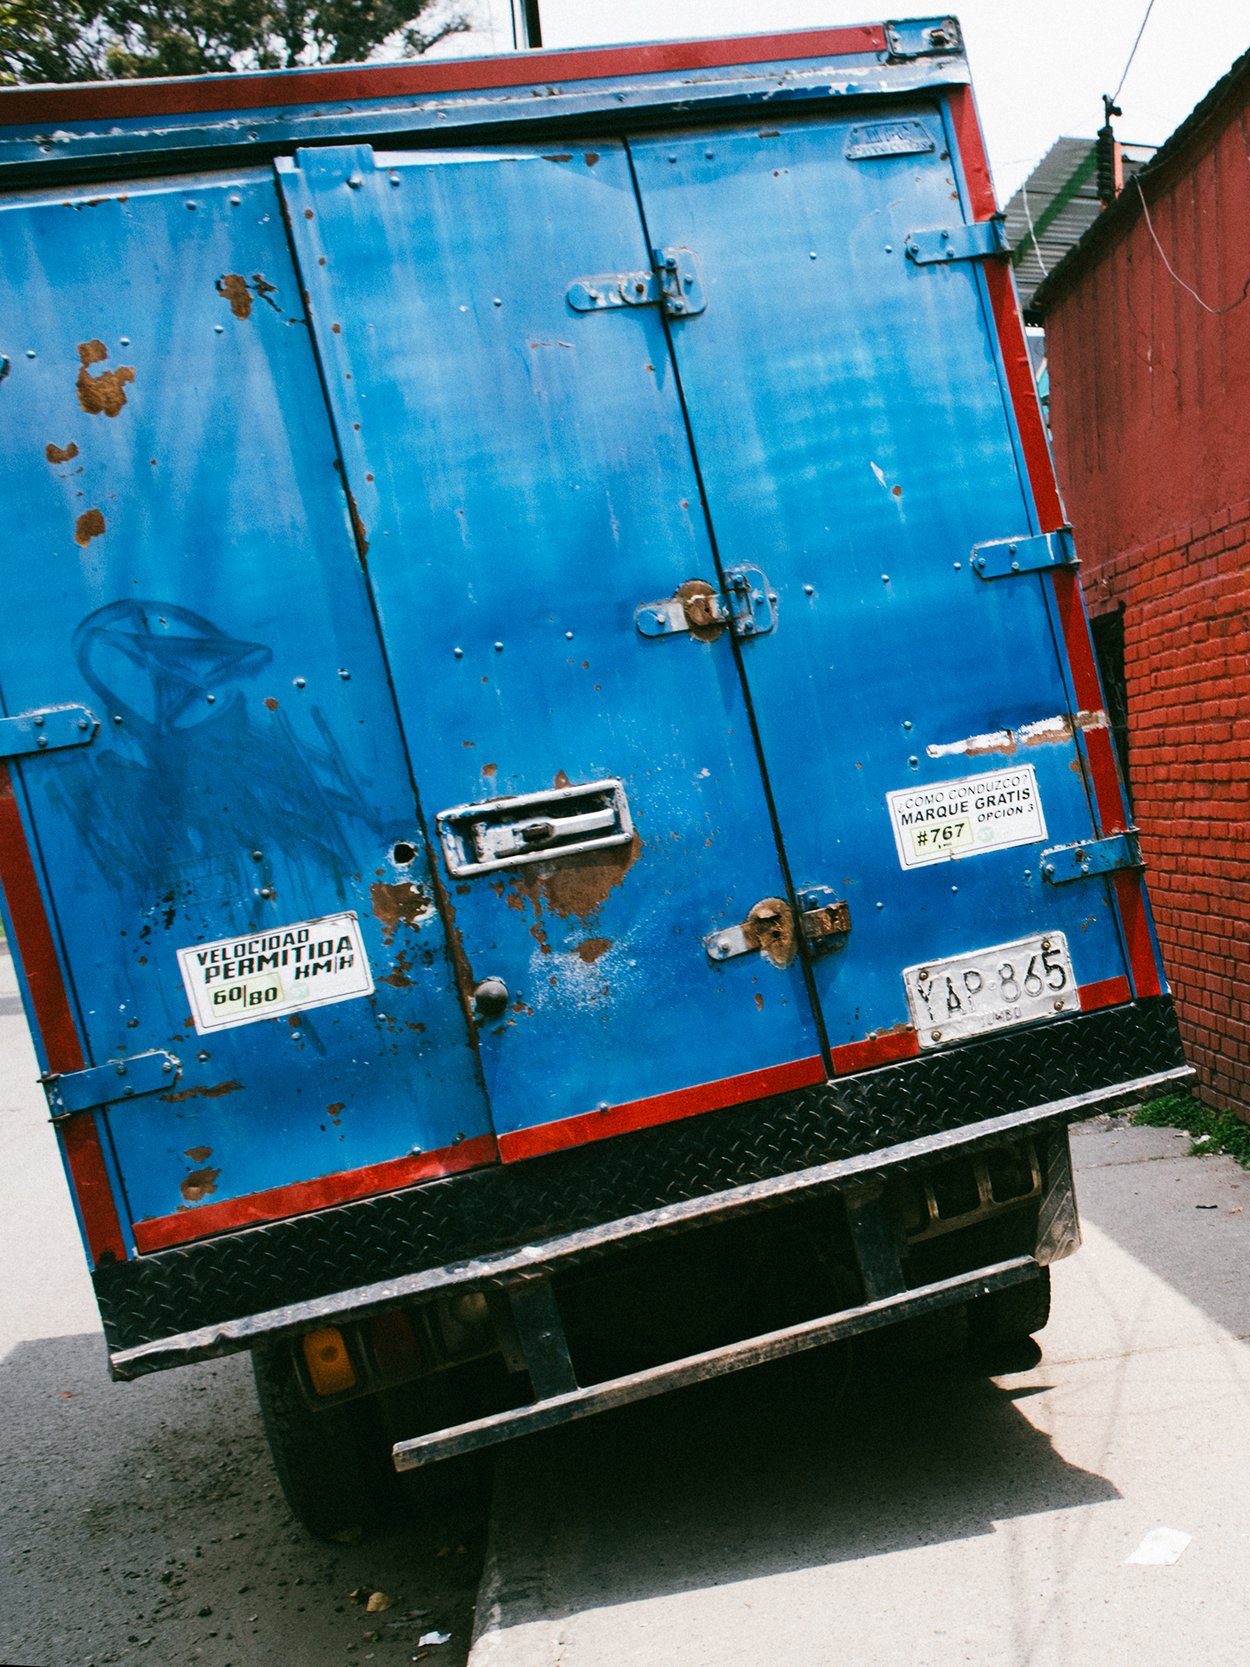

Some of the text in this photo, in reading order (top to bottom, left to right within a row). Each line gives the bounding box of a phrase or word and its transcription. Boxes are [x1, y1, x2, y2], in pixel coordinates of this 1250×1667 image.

[948, 774, 1028, 801] CONDUZCO?
[901, 787, 1031, 826] MARQUE GRATIS
[977, 803, 1034, 823] OPCION 3
[916, 823, 965, 847] #767
[196, 929, 309, 966] VELOCIDAD
[205, 936, 354, 984] PERMITIDA
[917, 949, 1067, 1023] YAP 865
